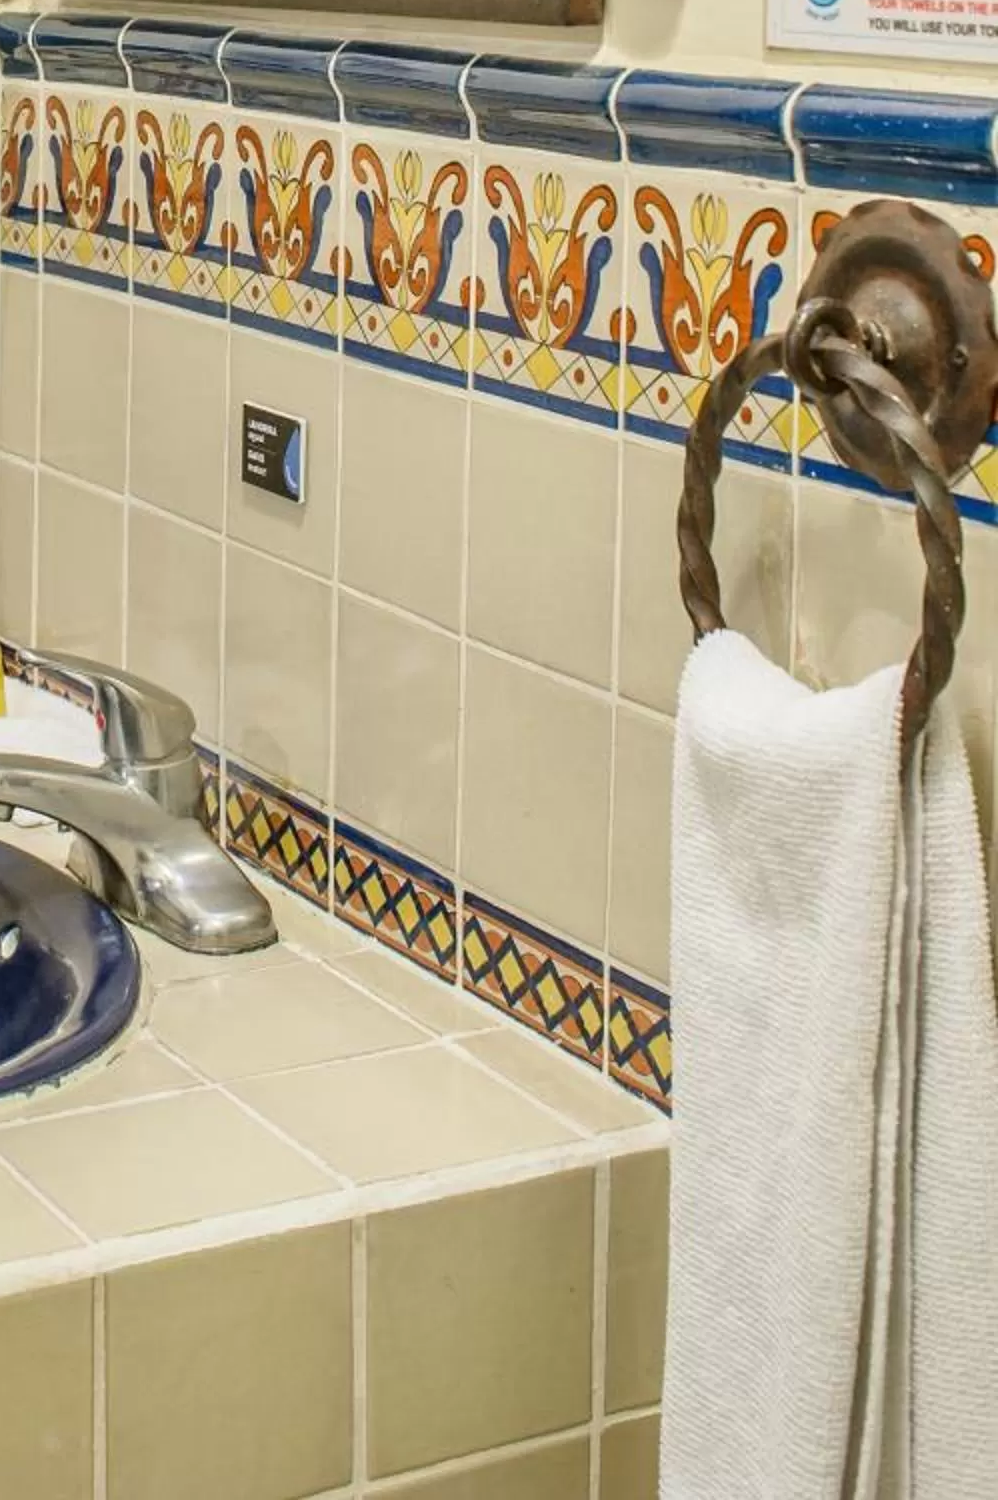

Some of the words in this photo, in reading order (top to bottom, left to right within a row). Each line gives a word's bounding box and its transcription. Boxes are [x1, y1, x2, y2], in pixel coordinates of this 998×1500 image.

[947, 0, 965, 13] ON
[968, 1, 987, 15] THE
[868, 18, 891, 31] YOU
[893, 19, 919, 33] WILL
[921, 20, 943, 35] USE
[945, 22, 977, 37] YOUR
